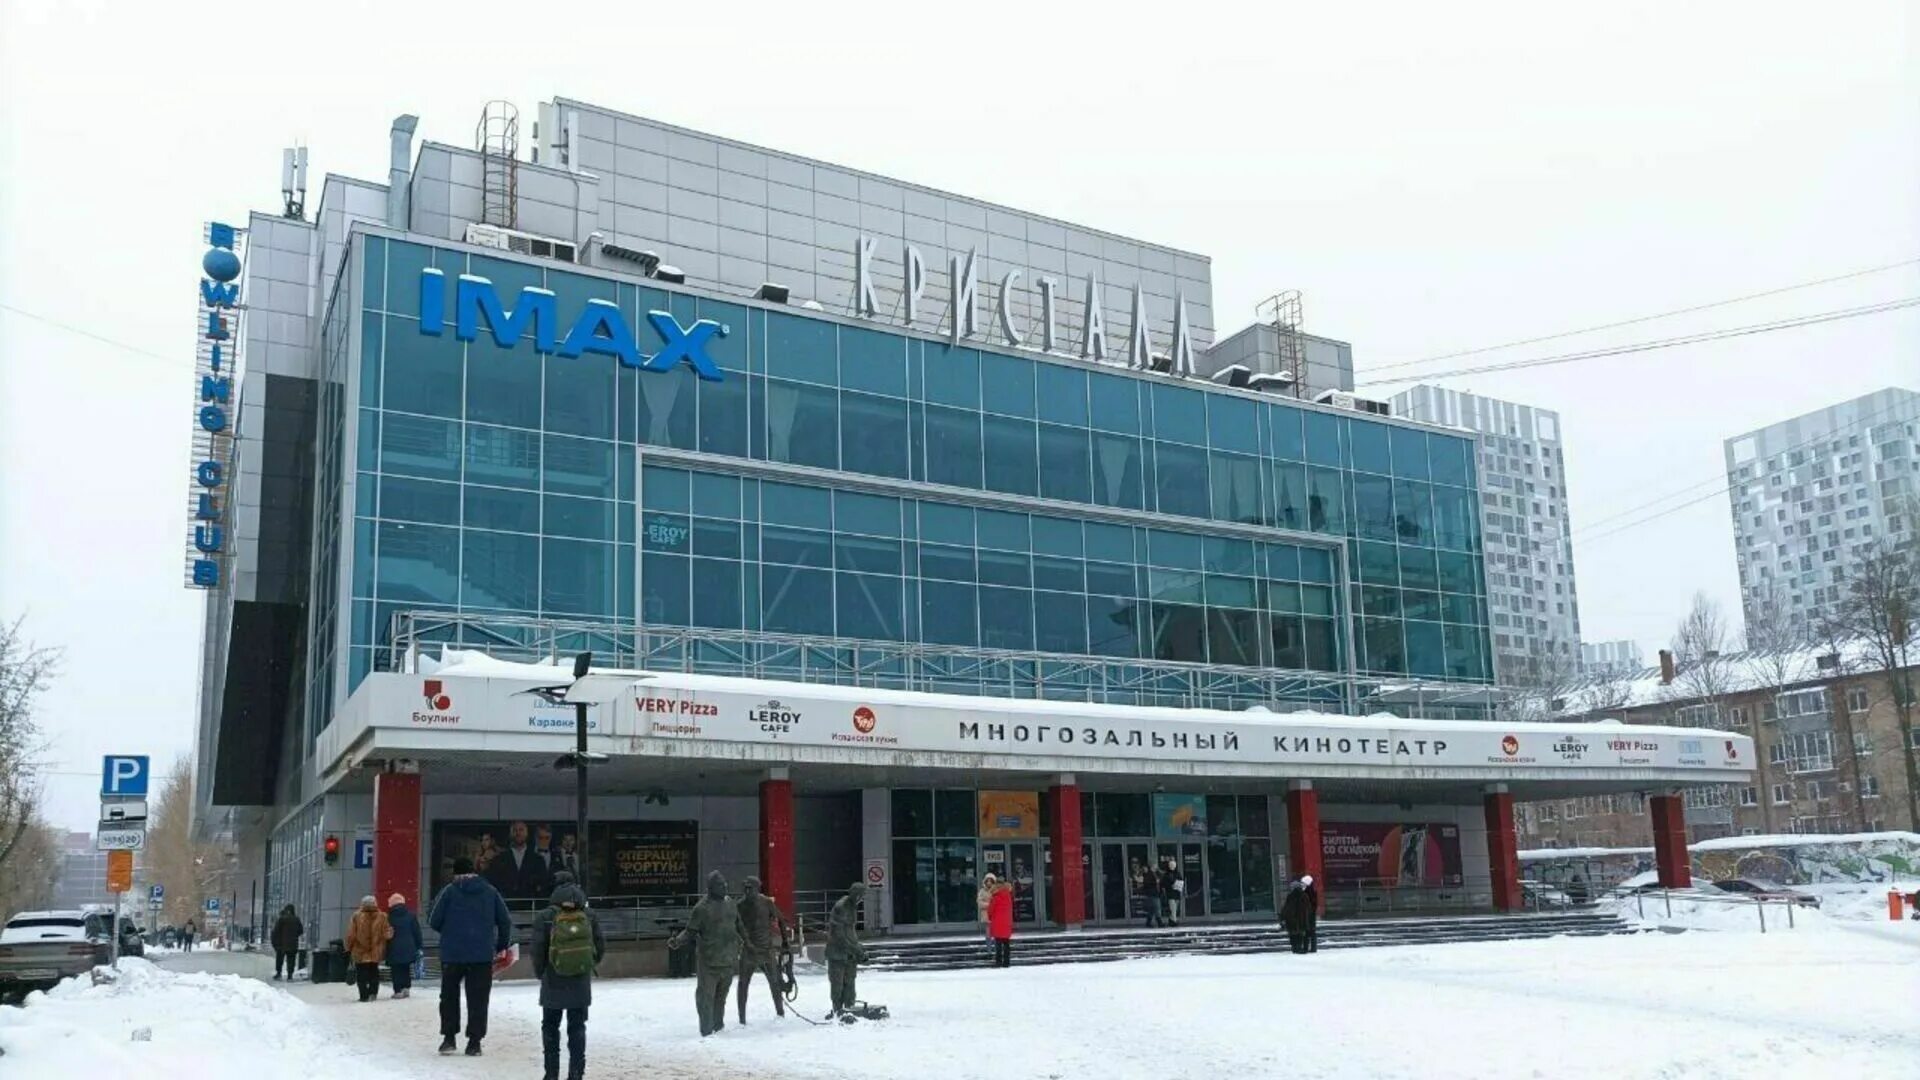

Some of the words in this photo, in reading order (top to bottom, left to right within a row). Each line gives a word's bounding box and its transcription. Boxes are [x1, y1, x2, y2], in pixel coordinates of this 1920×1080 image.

[855, 232, 1197, 378] КРИСТАЛЛ
[643, 524, 688, 540] EROY
[635, 697, 676, 713] VERY
[680, 700, 718, 716] Pizza
[412, 712, 461, 724] Боулинг
[528, 716, 575, 728] Караоке
[749, 710, 802, 724] LEROY
[760, 723, 790, 733] CAFE
[958, 720, 1239, 751] МНОГОЗАЛЬНЫЙ
[1273, 735, 1448, 756] КИНОТЕАТР
[1552, 743, 1589, 753] LEROY
[1606, 740, 1632, 751] VERY
[1634, 740, 1659, 751] Pizza
[616, 849, 689, 861] ОПЕРАЦИЯ
[1323, 845, 1336, 855] СО
[1337, 843, 1381, 856] СКИДКОЙ
[619, 861, 688, 872] ФОРТУНА
